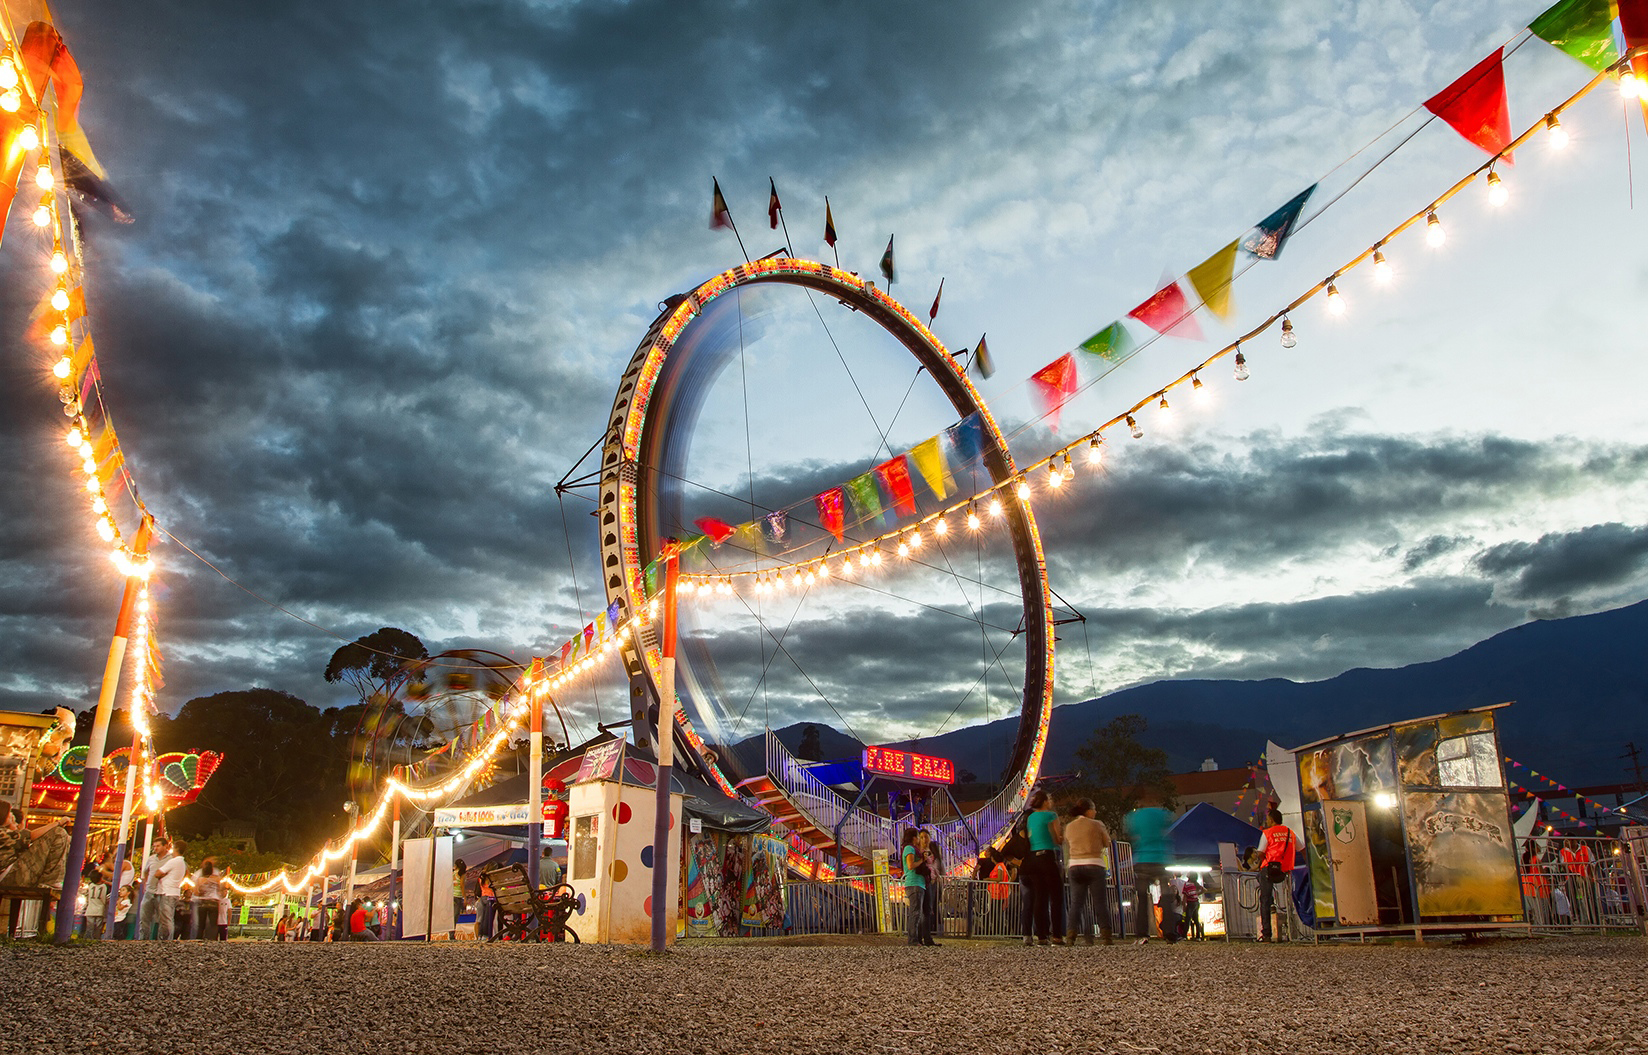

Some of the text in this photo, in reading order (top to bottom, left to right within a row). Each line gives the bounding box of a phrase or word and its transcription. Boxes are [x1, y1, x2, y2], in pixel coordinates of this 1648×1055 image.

[867, 748, 950, 779] FIRE BALL
[1335, 815, 1352, 839] CALI
[91, 886, 103, 899] 11
